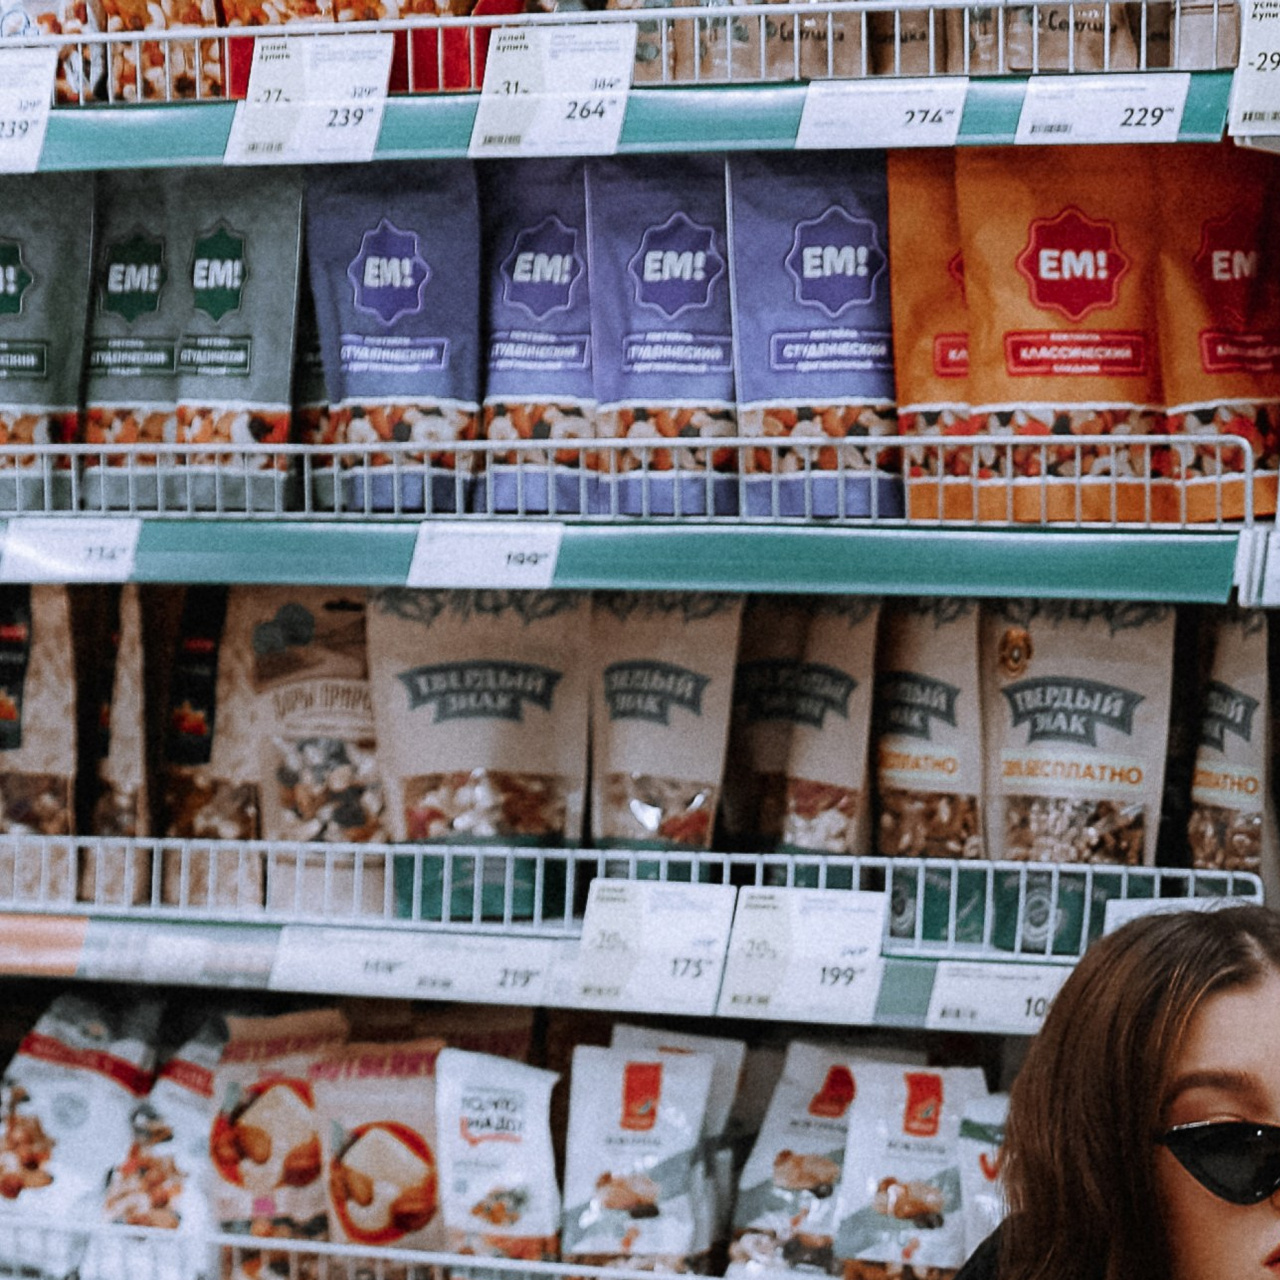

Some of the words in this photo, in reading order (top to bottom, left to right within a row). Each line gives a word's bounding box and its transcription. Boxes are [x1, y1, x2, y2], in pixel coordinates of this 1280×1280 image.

[325, 107, 366, 129] 239
[565, 101, 606, 121] 264
[1119, 107, 1165, 128] 229
